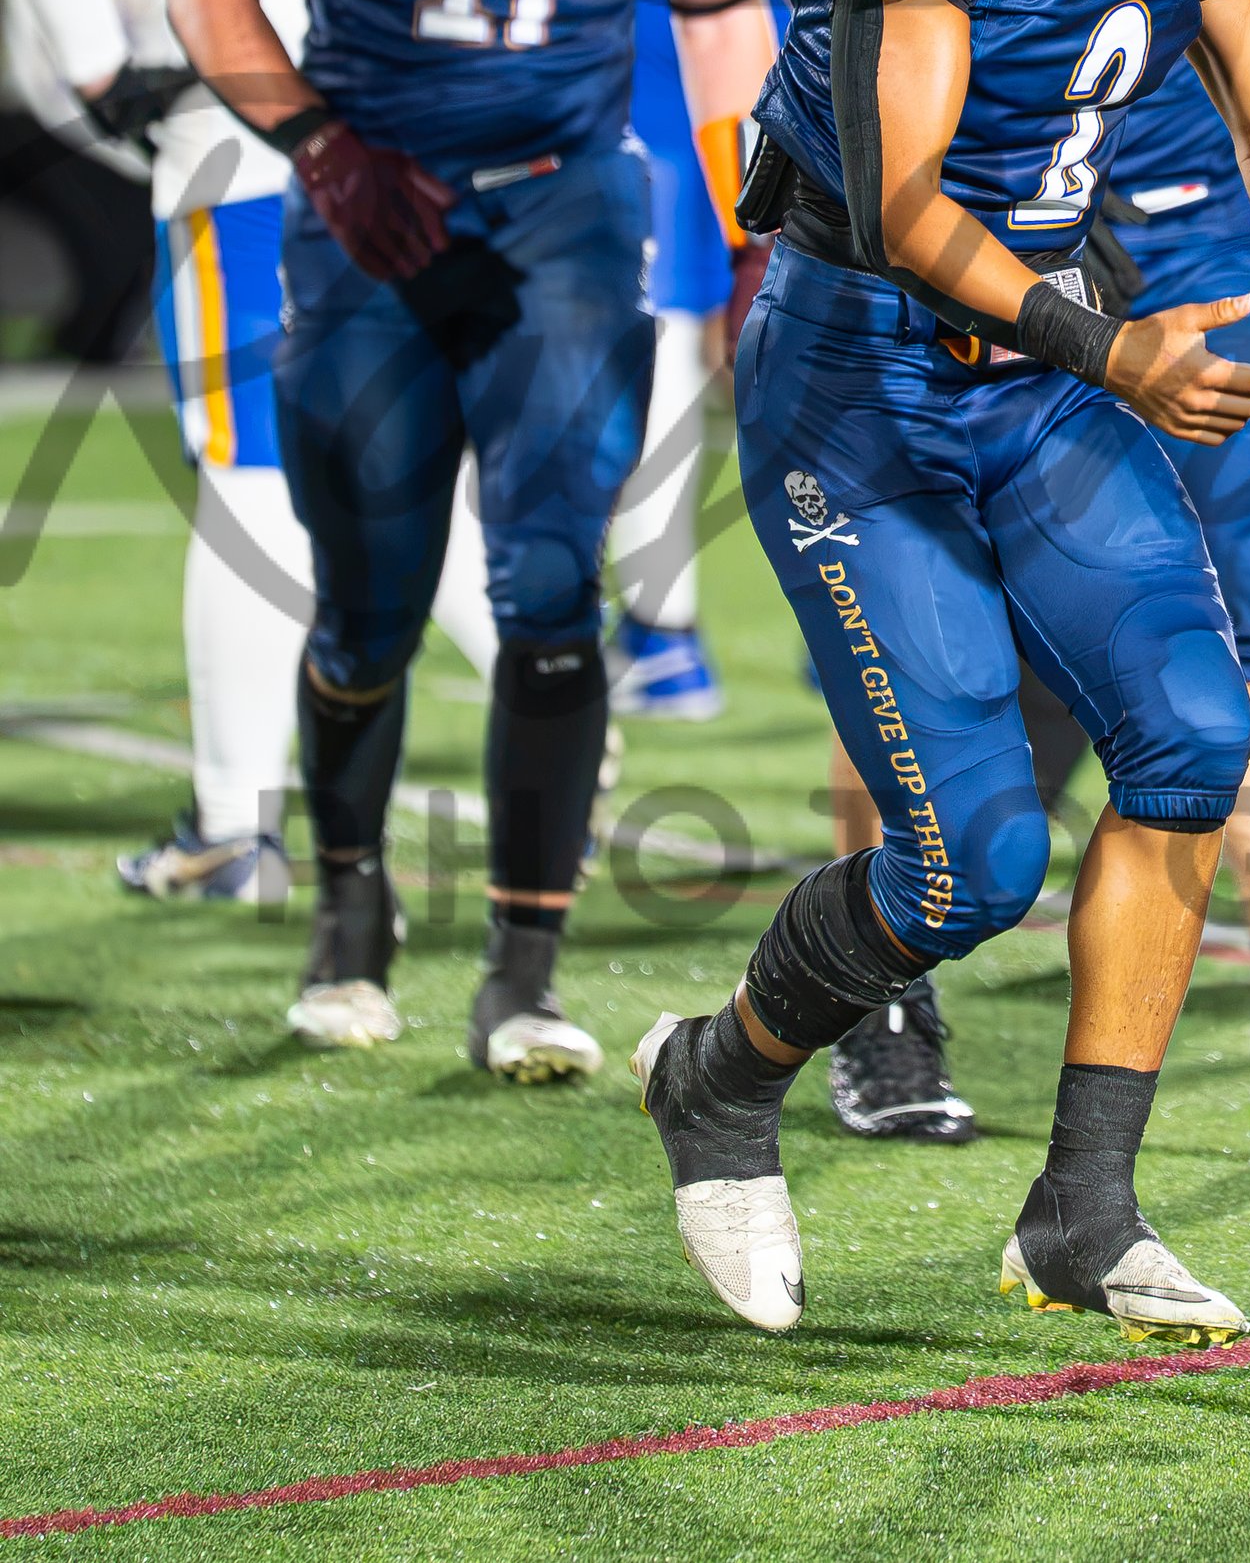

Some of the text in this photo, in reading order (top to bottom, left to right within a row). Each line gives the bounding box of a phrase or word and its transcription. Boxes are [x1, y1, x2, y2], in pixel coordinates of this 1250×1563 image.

[1007, 0, 1152, 230] 2
[818, 560, 880, 666] DON'T
[860, 666, 909, 743] GIVE
[890, 747, 927, 796] UP
[909, 801, 951, 868] THE
